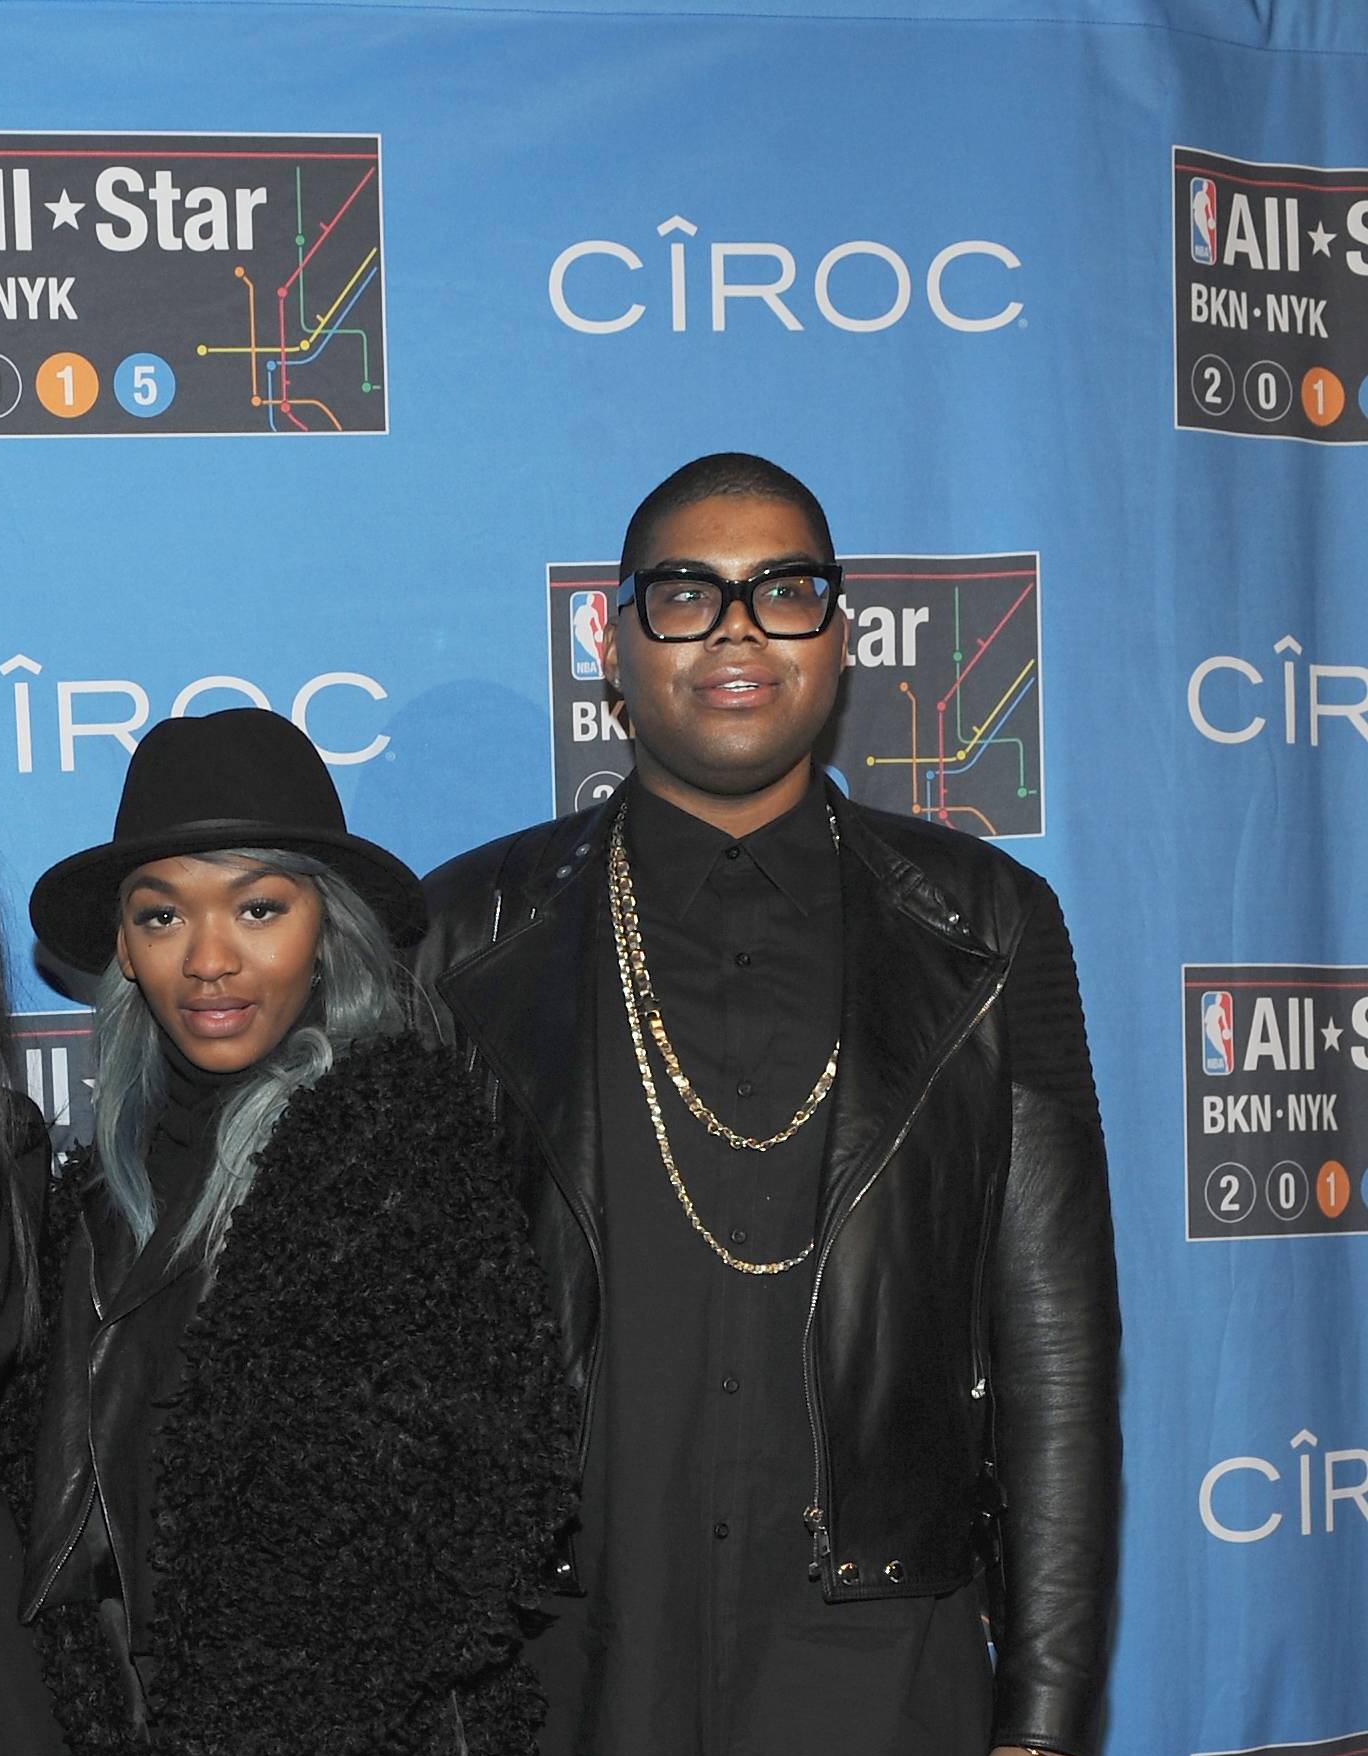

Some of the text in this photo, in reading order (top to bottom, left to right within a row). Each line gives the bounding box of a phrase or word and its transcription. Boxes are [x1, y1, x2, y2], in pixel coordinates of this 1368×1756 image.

[96, 167, 266, 251] Star
[1224, 194, 1299, 271] All
[549, 215, 1023, 334] CÎROC
[1243, 998, 1314, 1071] All
